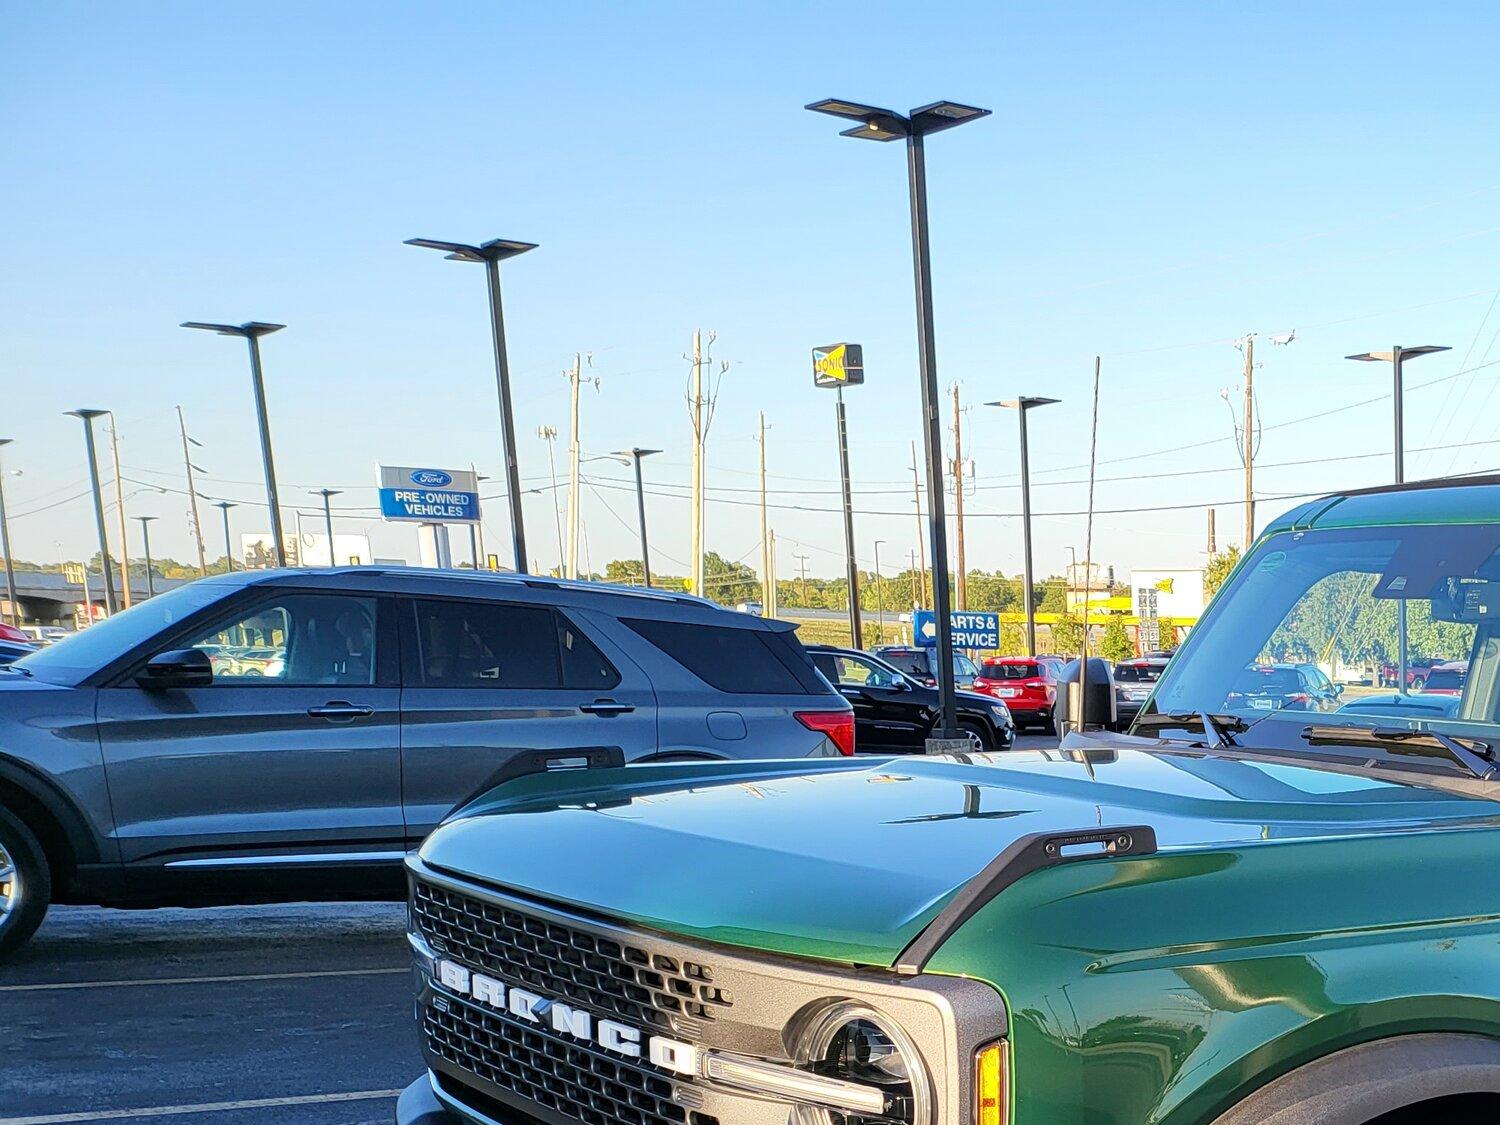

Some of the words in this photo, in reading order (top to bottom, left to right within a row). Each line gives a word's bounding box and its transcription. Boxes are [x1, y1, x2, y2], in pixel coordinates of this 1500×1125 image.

[814, 357, 845, 373] SONIC
[394, 491, 470, 505] PRE-OWNED
[404, 503, 464, 517] VEHICLES
[950, 615, 985, 630] ARTS
[986, 616, 996, 630] &
[951, 632, 997, 647] ERVICE
[440, 959, 697, 1076] BRONCO
